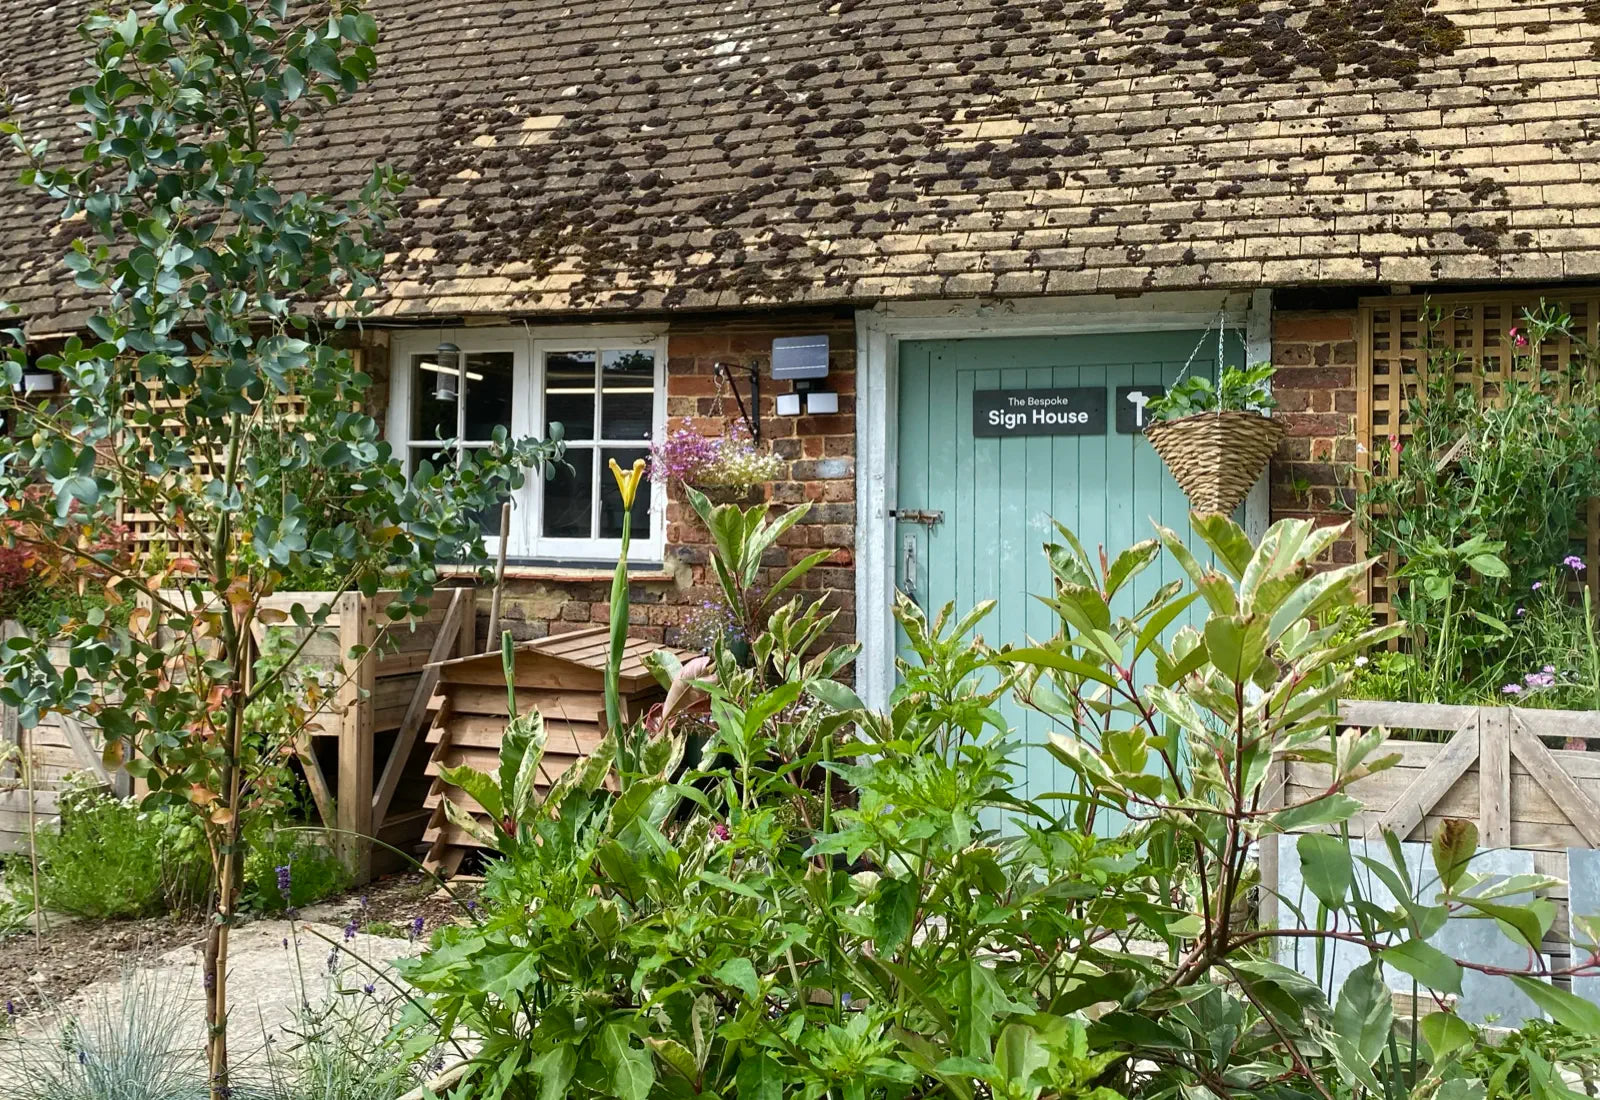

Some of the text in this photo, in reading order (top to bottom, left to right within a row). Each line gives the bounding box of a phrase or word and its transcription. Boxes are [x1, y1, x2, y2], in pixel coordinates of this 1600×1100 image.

[1008, 396, 1069, 407] The Bespoke
[988, 408, 1089, 430] Sign House
